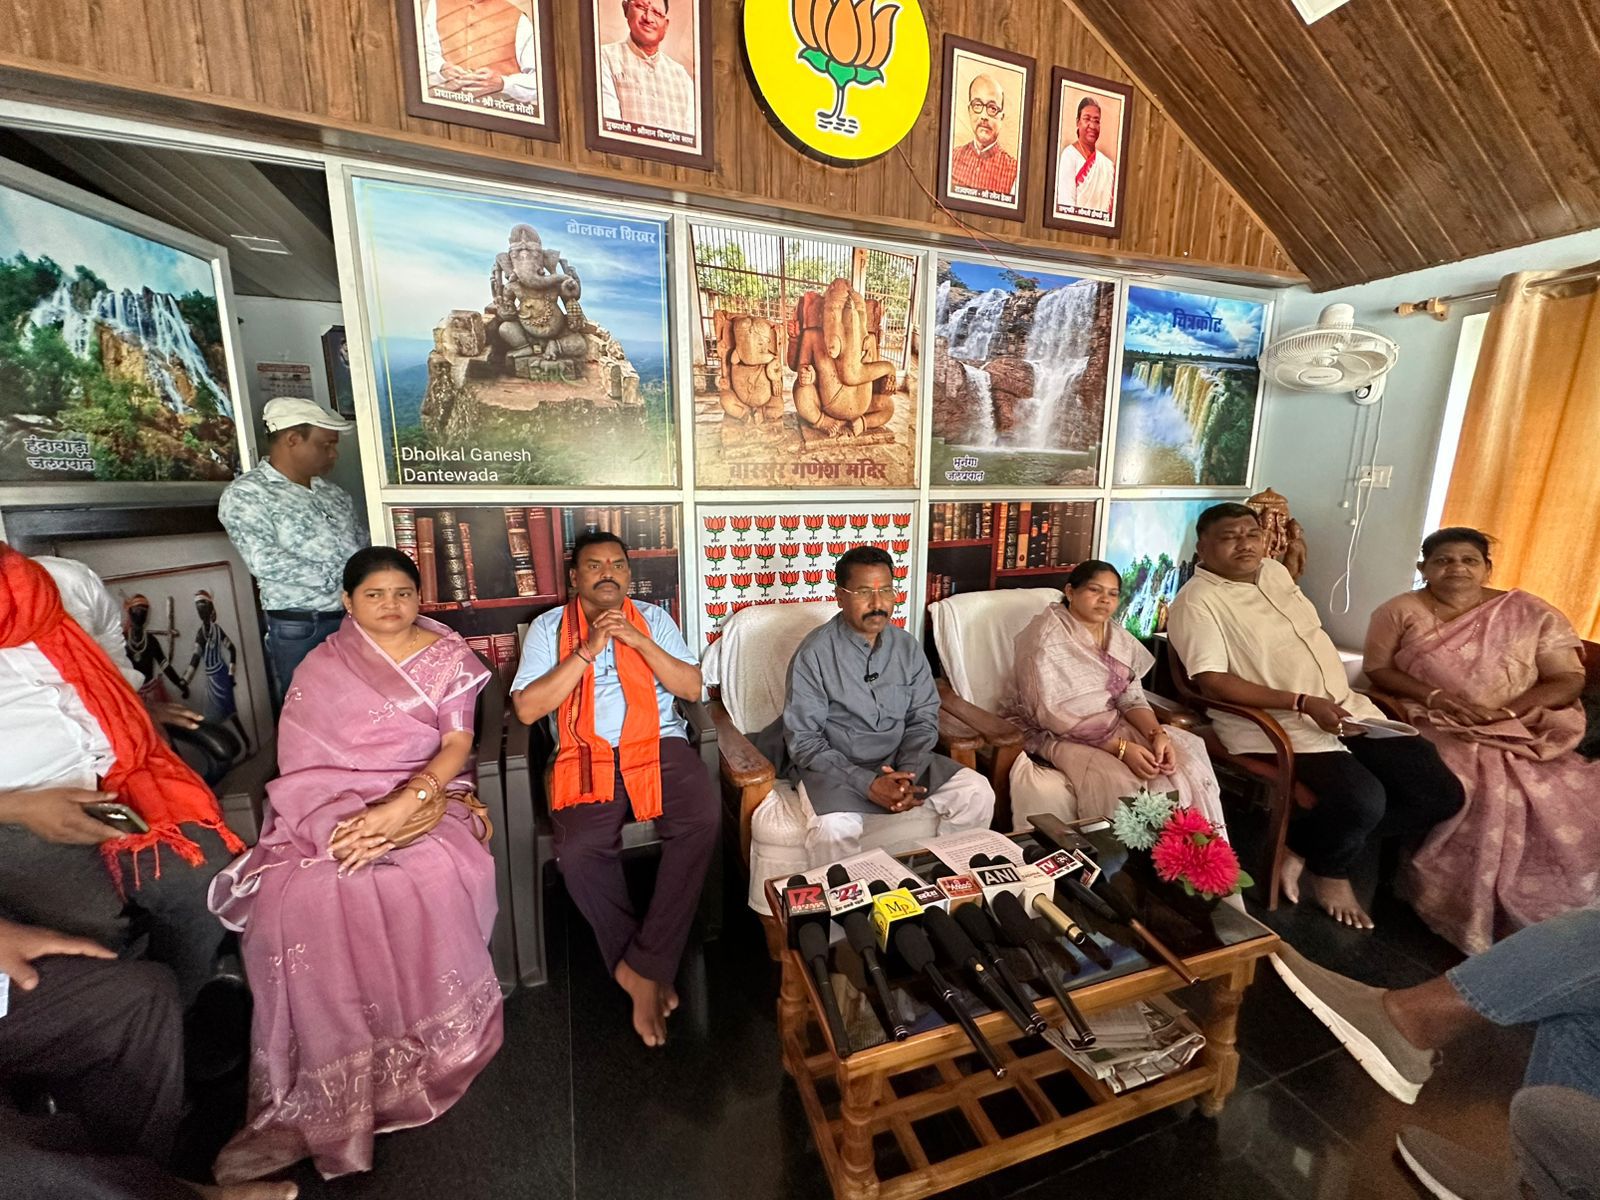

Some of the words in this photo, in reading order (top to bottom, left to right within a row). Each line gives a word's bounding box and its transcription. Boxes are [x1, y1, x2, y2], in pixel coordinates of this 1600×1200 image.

[482, 96, 494, 108] श्री
[515, 102, 535, 115] मोदी
[620, 225, 656, 244] शिखर
[1172, 308, 1223, 333] चित्रकोट
[401, 446, 465, 461] Dholkal
[470, 447, 532, 462] Ganesh
[403, 467, 499, 482] Dantewada
[791, 457, 841, 479] गणेश
[844, 458, 887, 480] मंदिर
[985, 867, 1019, 885] ANI
